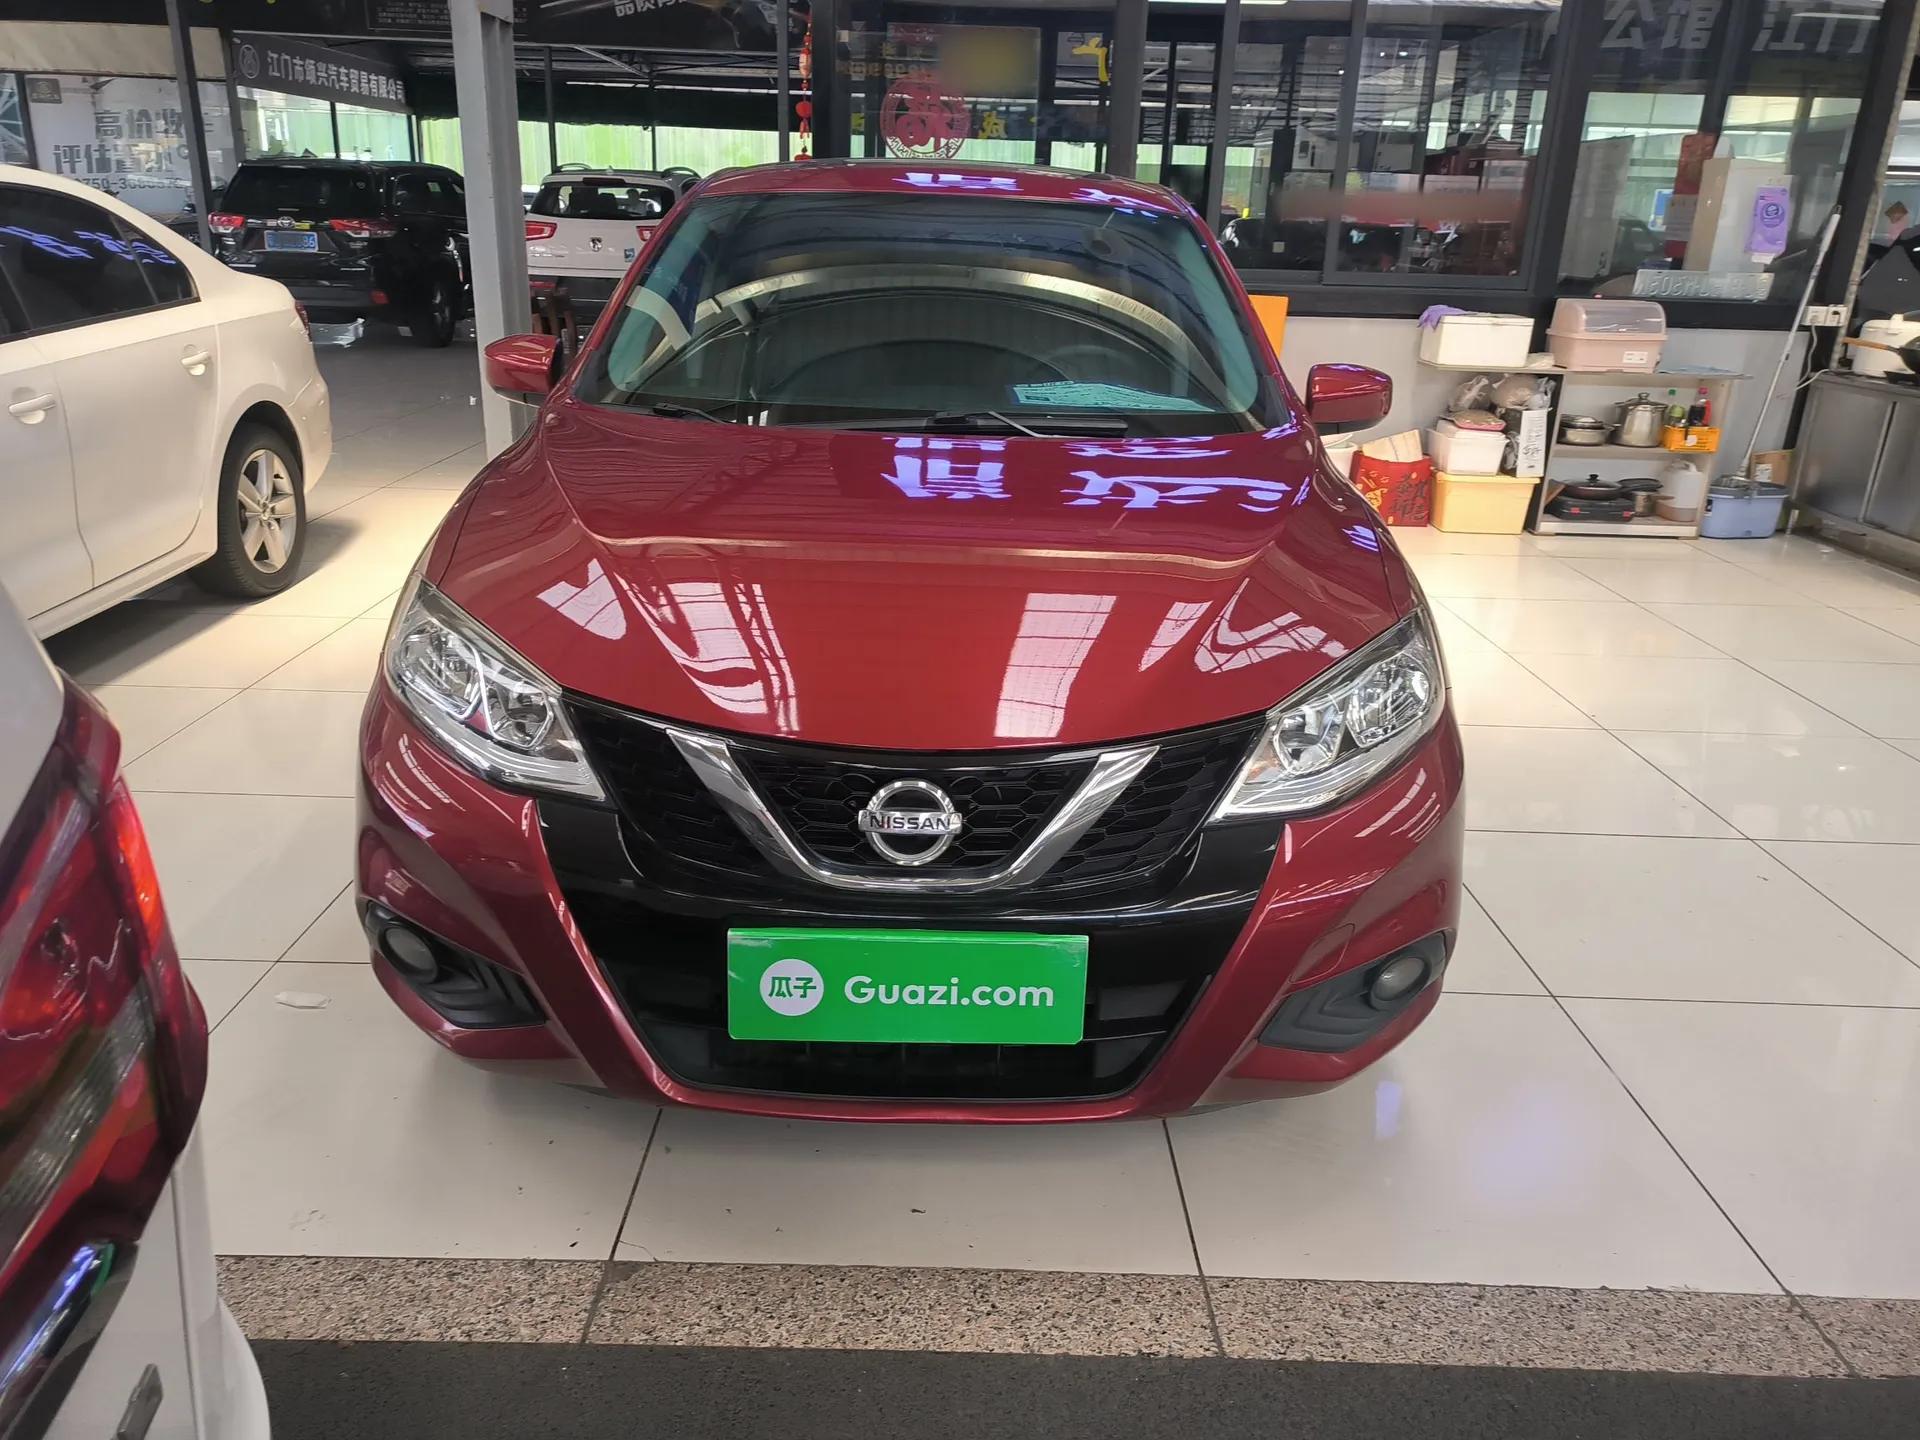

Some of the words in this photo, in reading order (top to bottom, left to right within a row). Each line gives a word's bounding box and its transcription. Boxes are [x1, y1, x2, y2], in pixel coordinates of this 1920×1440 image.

[868, 813, 952, 831] NISSAN
[768, 975, 817, 999] 瓜子
[843, 974, 1055, 1007] Guazi.com
